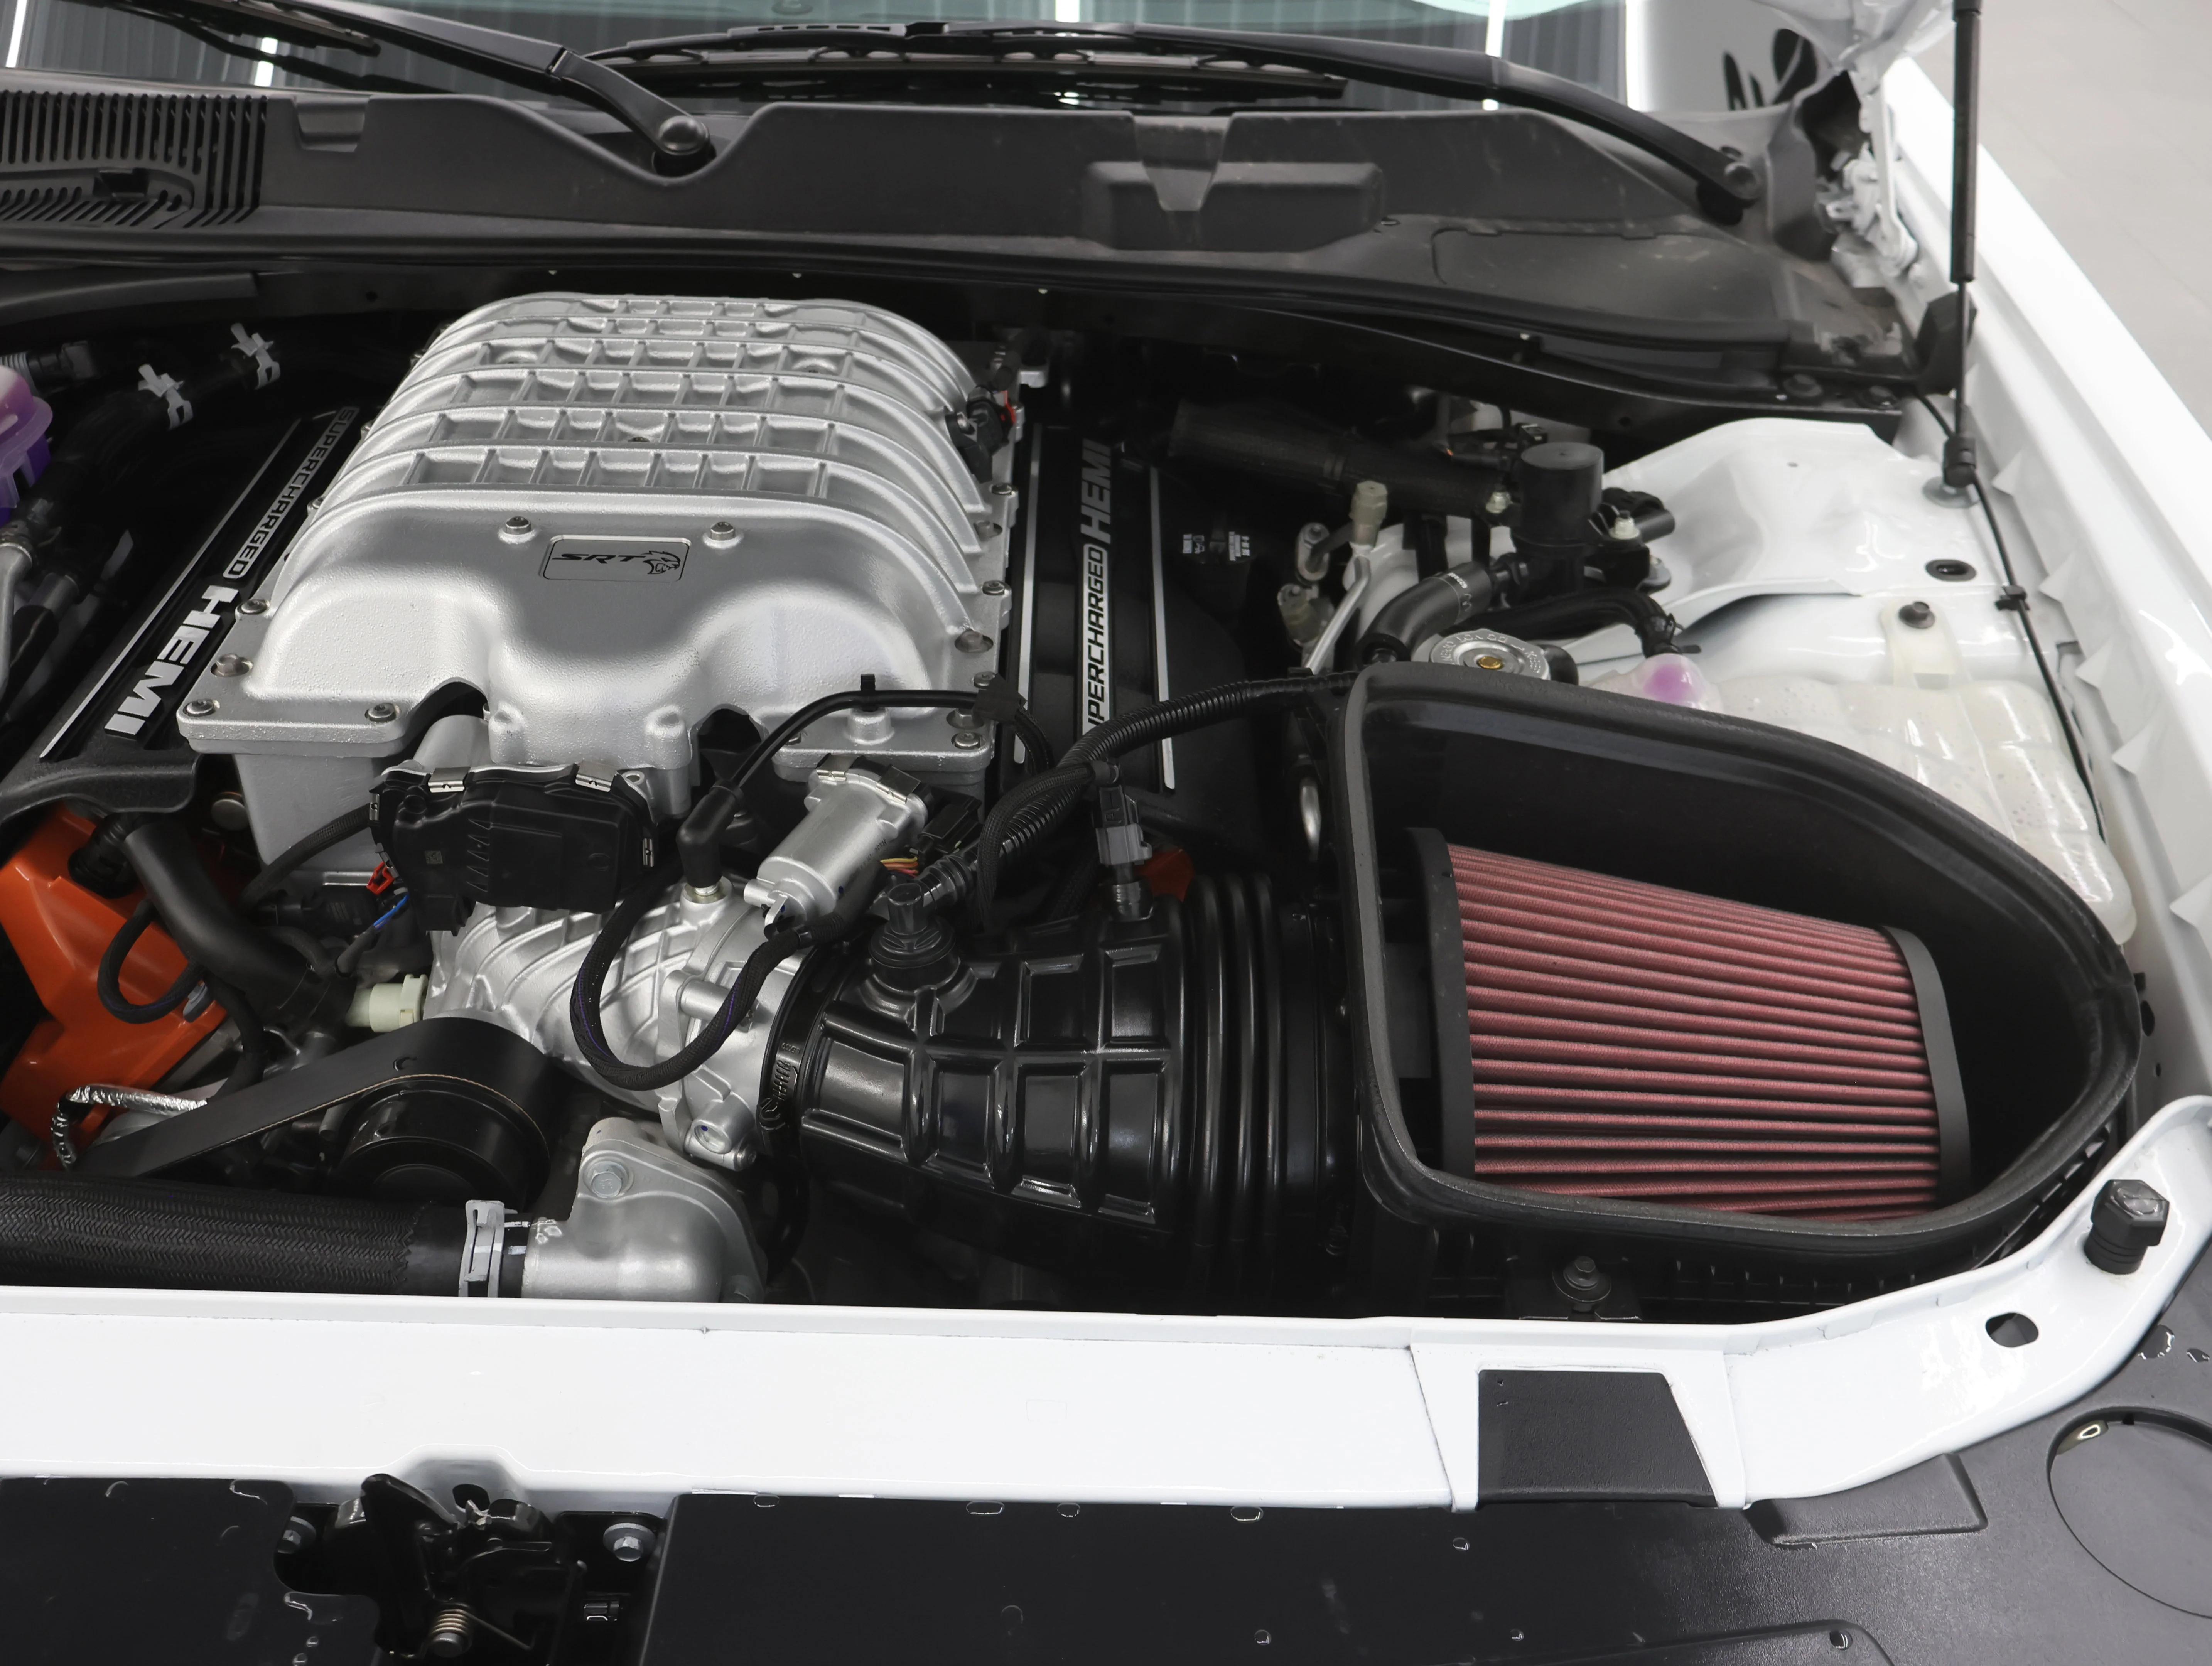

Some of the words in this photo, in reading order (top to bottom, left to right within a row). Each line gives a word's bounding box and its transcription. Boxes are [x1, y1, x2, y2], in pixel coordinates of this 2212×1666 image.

[228, 409, 354, 576] SUPERCHARGED
[552, 553, 646, 564] SRT
[1080, 438, 1111, 544] HEMI
[105, 585, 239, 736] HEMI
[1087, 546, 1105, 726] PERCHARGED
